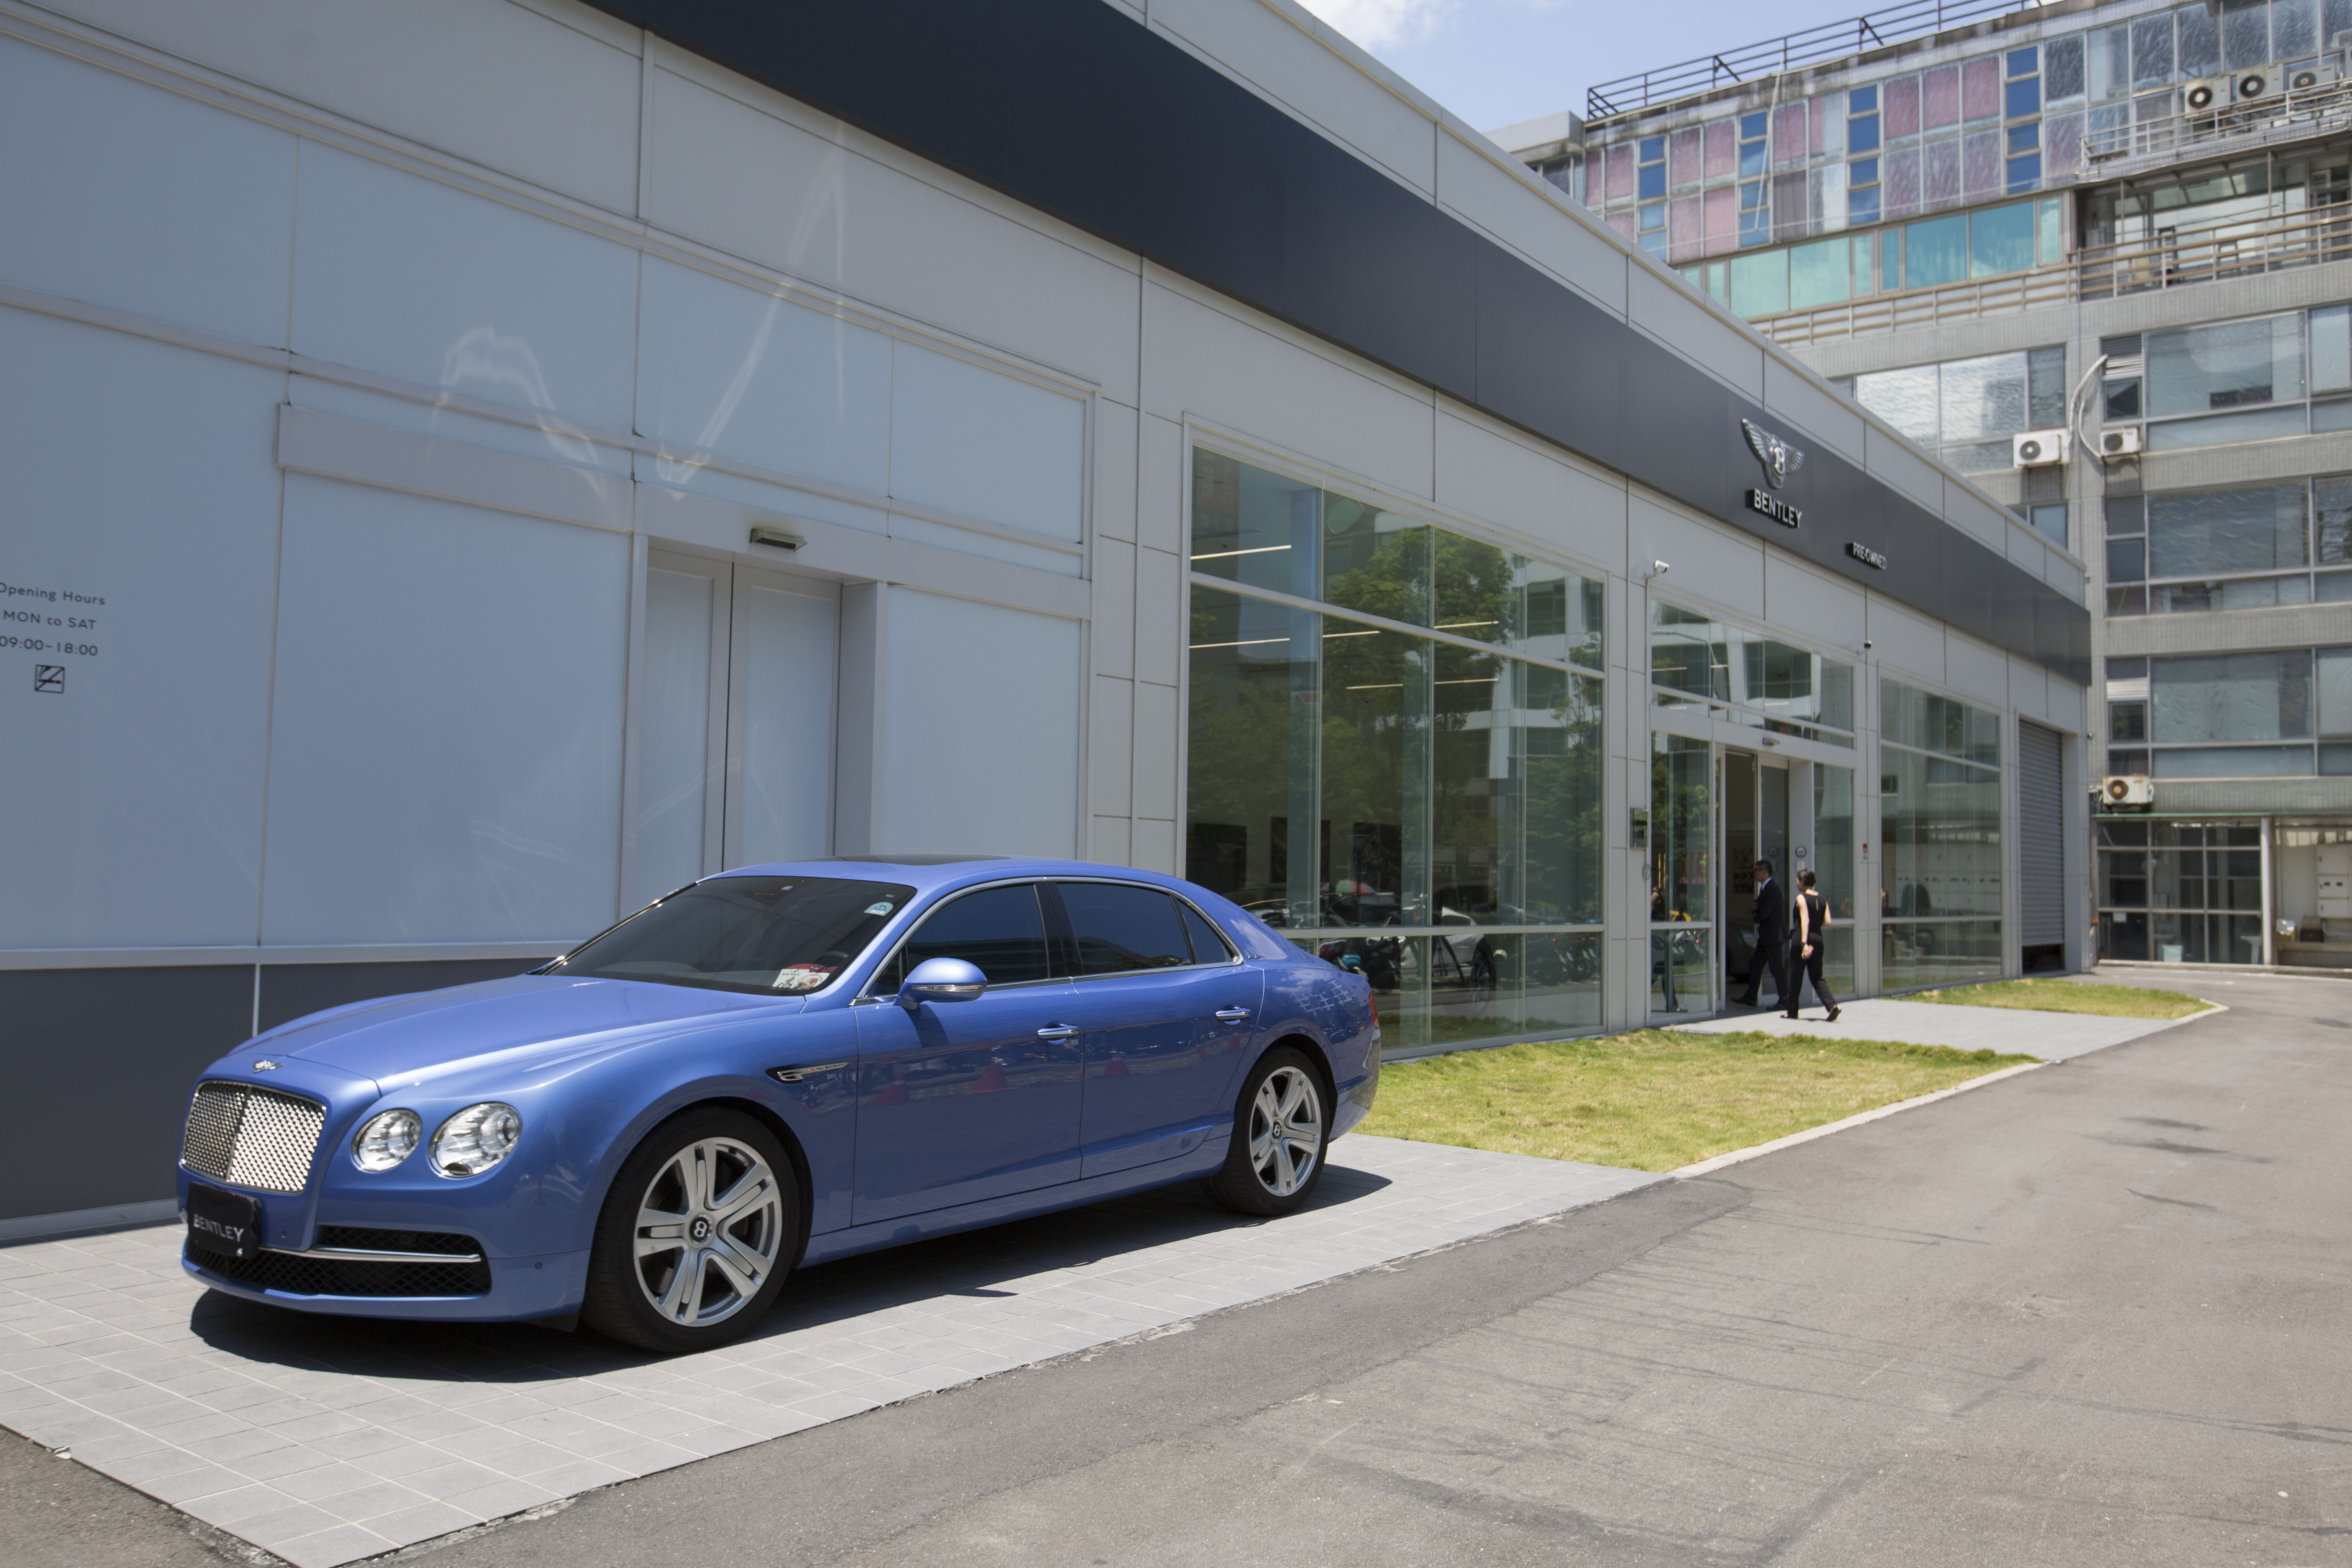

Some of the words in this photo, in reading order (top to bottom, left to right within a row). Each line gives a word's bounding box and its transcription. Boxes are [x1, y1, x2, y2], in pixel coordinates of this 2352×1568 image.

[1754, 488, 1802, 528] BENTLEY
[1853, 542, 1887, 570] PRE-OWNED
[0, 583, 56, 601] Opening
[63, 591, 105, 605] Hours
[3, 610, 40, 624] MON
[47, 617, 62, 626] to
[69, 617, 97, 629] SAT
[194, 1214, 244, 1242] BENTLEY
